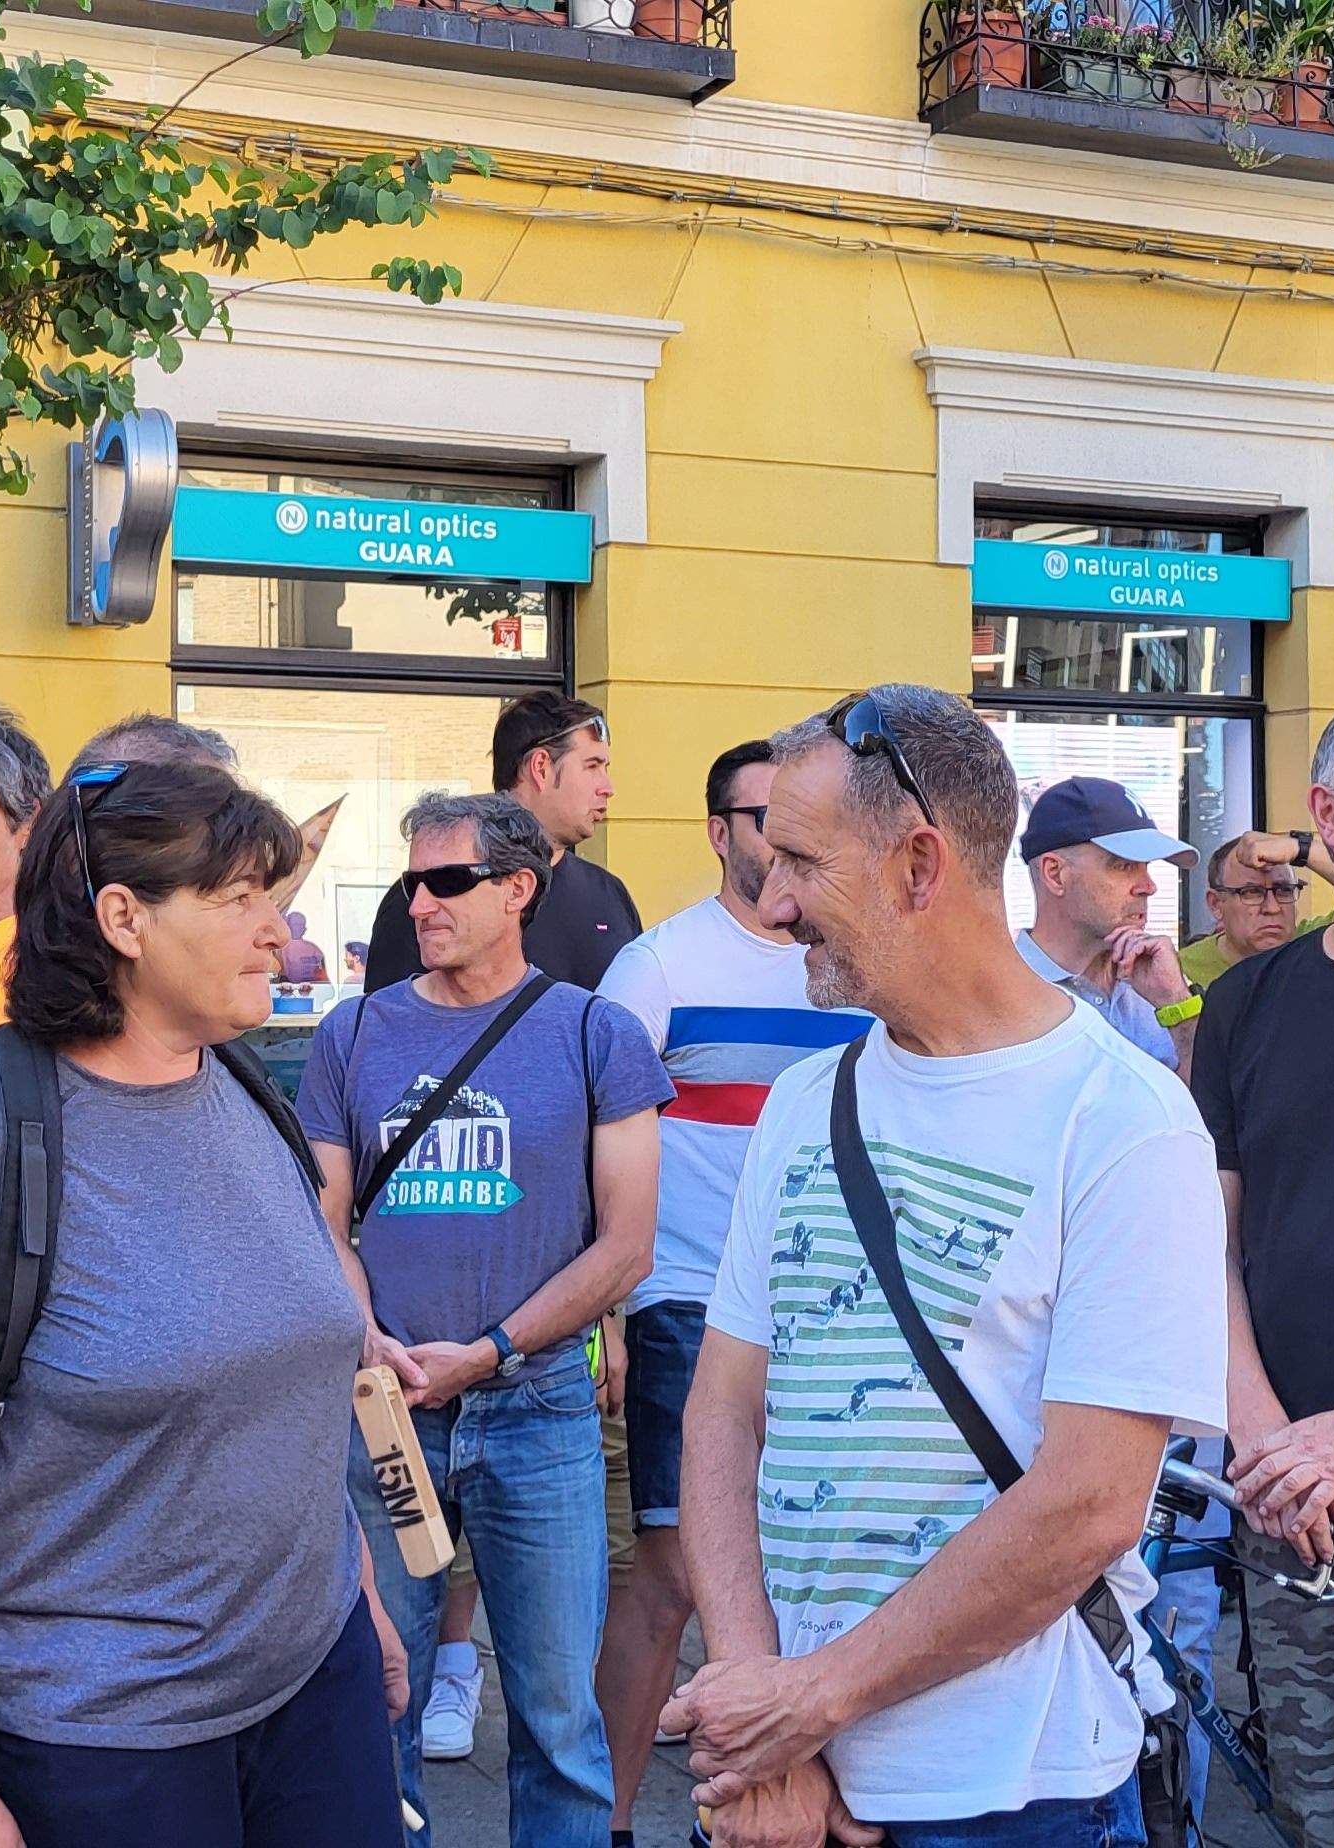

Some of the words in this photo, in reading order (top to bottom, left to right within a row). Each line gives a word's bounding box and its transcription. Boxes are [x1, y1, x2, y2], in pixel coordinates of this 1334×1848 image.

[316, 507, 411, 533] natural
[420, 513, 497, 541] optics
[359, 541, 454, 566] GUARA
[1075, 556, 1150, 578] natural
[1158, 560, 1218, 584] optics
[1110, 587, 1184, 607] GUARA
[386, 1179, 507, 1207] SOBRARBE
[372, 1443, 426, 1529] 15M
